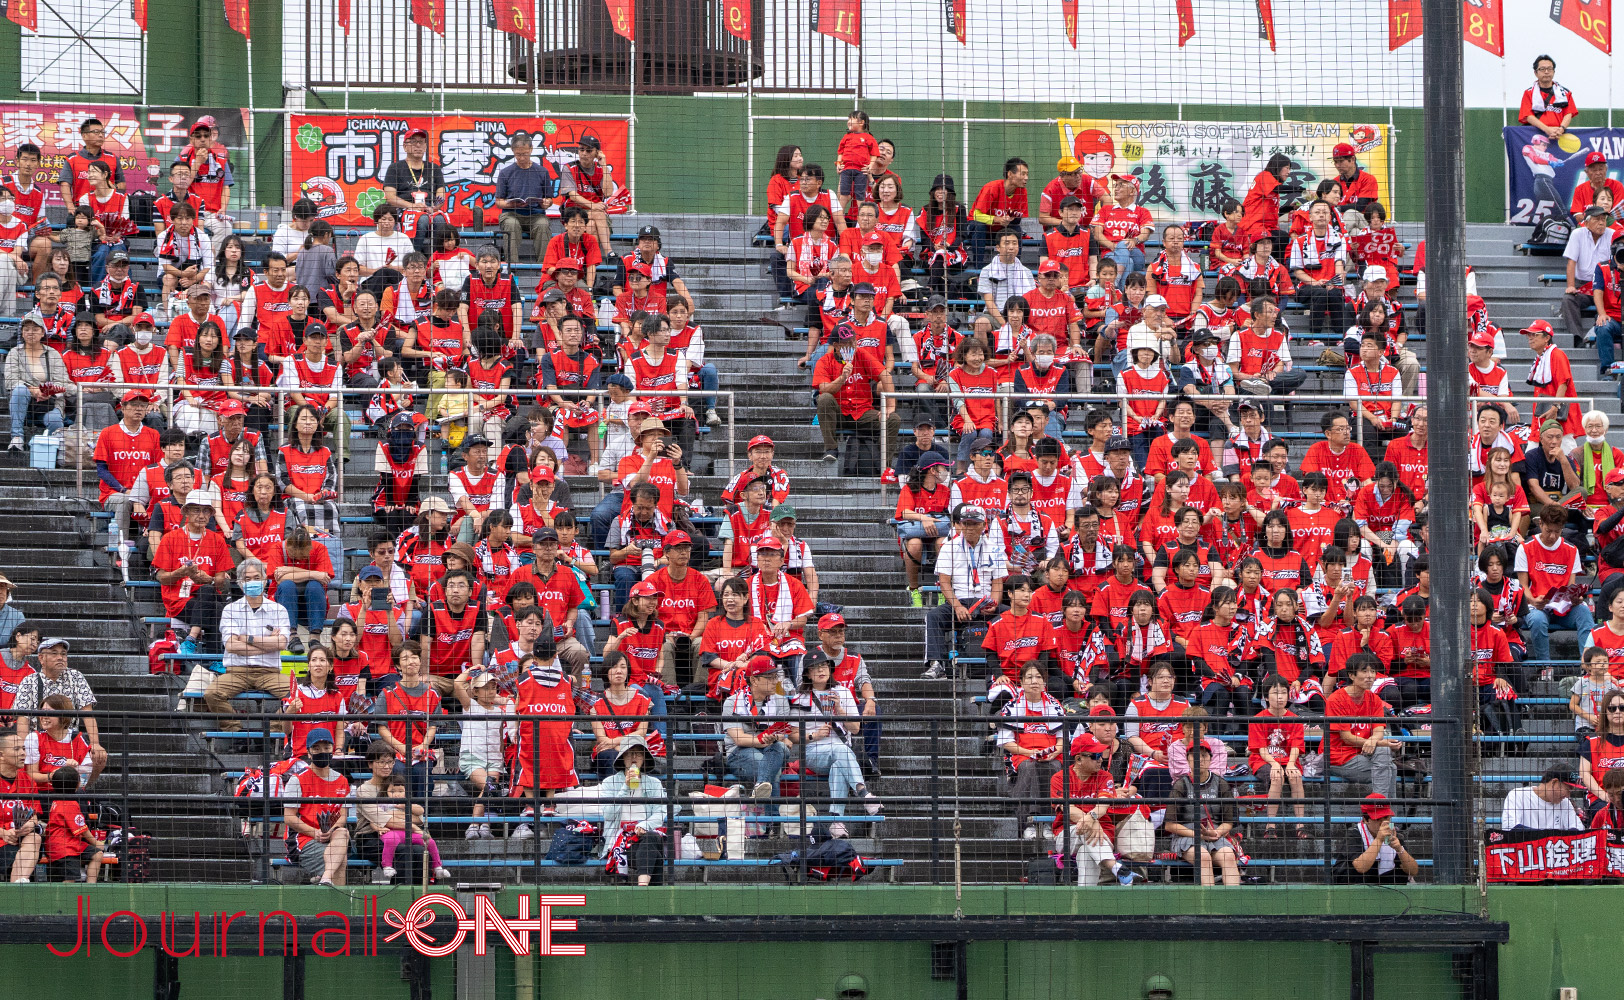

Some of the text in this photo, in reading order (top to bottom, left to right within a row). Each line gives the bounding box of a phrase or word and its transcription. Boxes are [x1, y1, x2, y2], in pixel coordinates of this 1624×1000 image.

[1394, 12, 1410, 38] 17
[475, 121, 506, 133] HINA
[1116, 123, 1341, 139] TOYOTA SOFTBALL TEAM
[1124, 144, 1142, 157] #13
[1510, 198, 1555, 225] 25
[114, 451, 150, 462] TOYOTA
[1321, 466, 1354, 478] TOYOTA
[968, 498, 1002, 508] TOYOTA
[1030, 497, 1066, 509] TOYOTA
[1290, 527, 1332, 538] TOYOTA
[244, 533, 282, 547] TOYOTA
[527, 704, 567, 714] TOYOTA
[1490, 835, 1598, 876] 下山絵理
